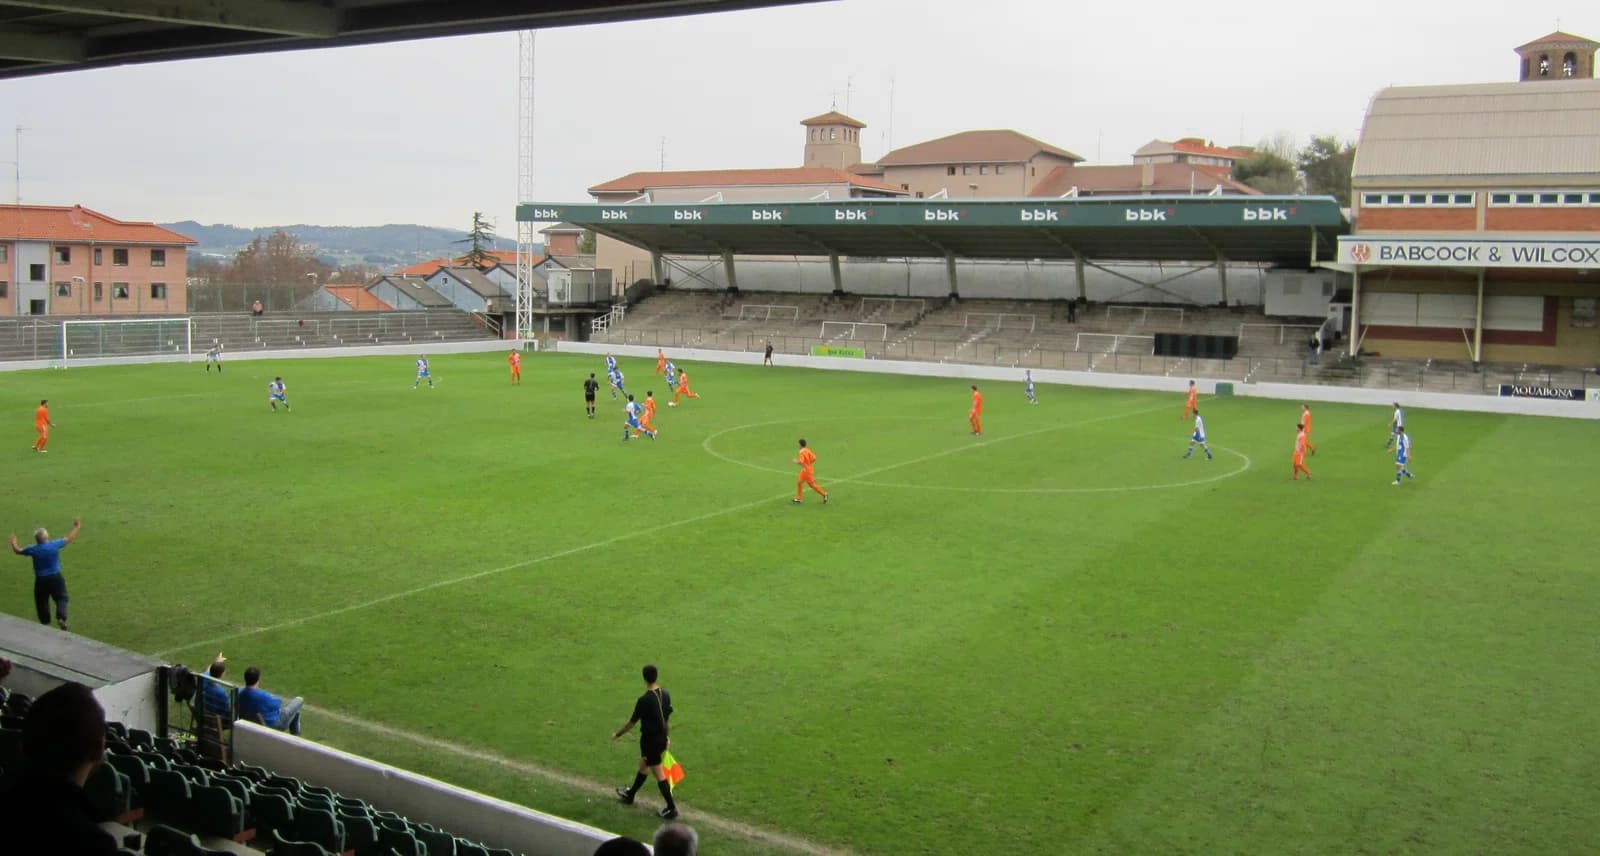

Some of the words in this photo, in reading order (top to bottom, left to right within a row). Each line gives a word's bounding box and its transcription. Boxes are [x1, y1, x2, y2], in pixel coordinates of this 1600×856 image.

[534, 208, 559, 219] bbk
[601, 209, 628, 220] bbk
[674, 209, 702, 220] bbk
[751, 209, 782, 221] bbk
[834, 209, 867, 221] bbk
[924, 209, 959, 221] bbk
[1021, 209, 1059, 221] bbk
[1125, 209, 1166, 221] bbk
[1243, 207, 1287, 221] bbk
[1380, 245, 1480, 262] BABCOCK
[1488, 247, 1502, 262] &
[1512, 246, 1600, 264] WILCOX
[1512, 385, 1573, 398] AQUABONA
